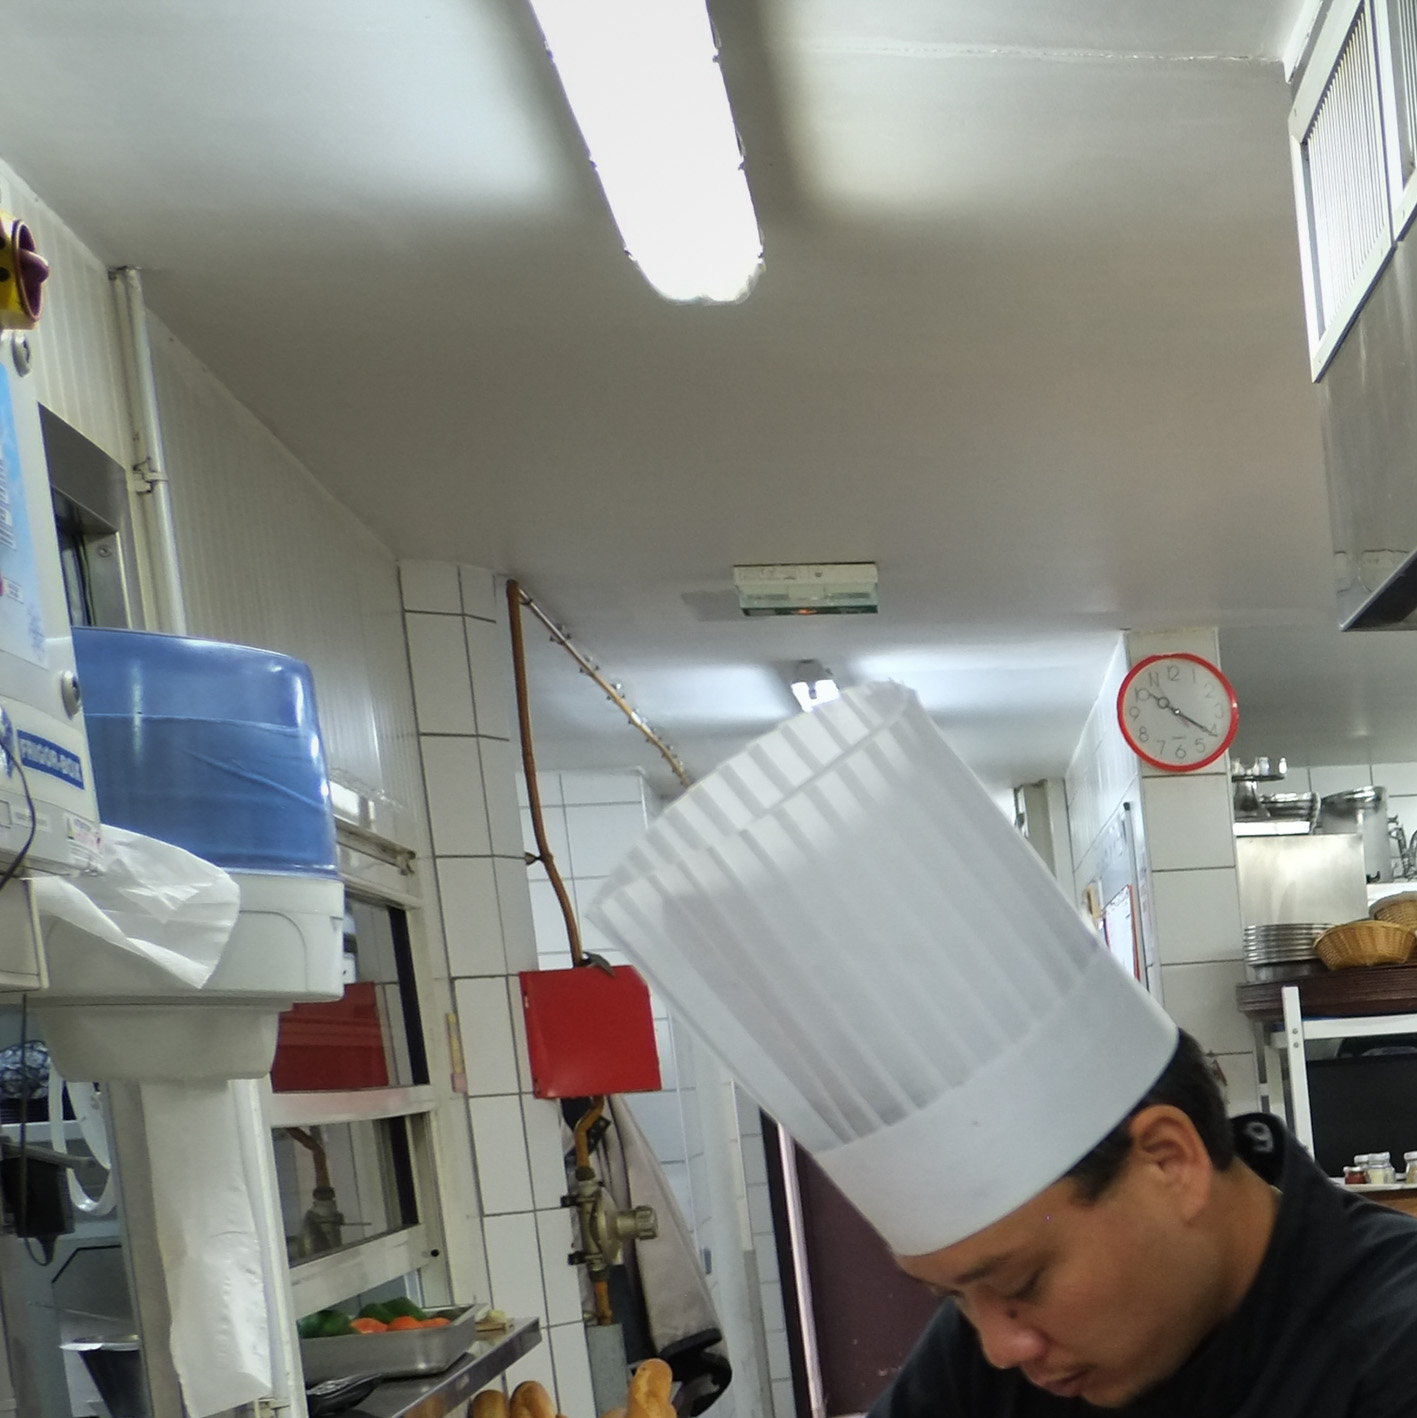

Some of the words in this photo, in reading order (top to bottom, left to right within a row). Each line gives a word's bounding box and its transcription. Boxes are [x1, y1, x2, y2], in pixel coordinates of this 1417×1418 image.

[1167, 665, 1181, 682] 12
[1203, 682, 1215, 699] 2
[1129, 706, 1140, 722] 9
[1139, 726, 1149, 744] 8
[1157, 740, 1166, 755] 7
[1175, 744, 1186, 760] 6
[1195, 738, 1206, 753] 5
